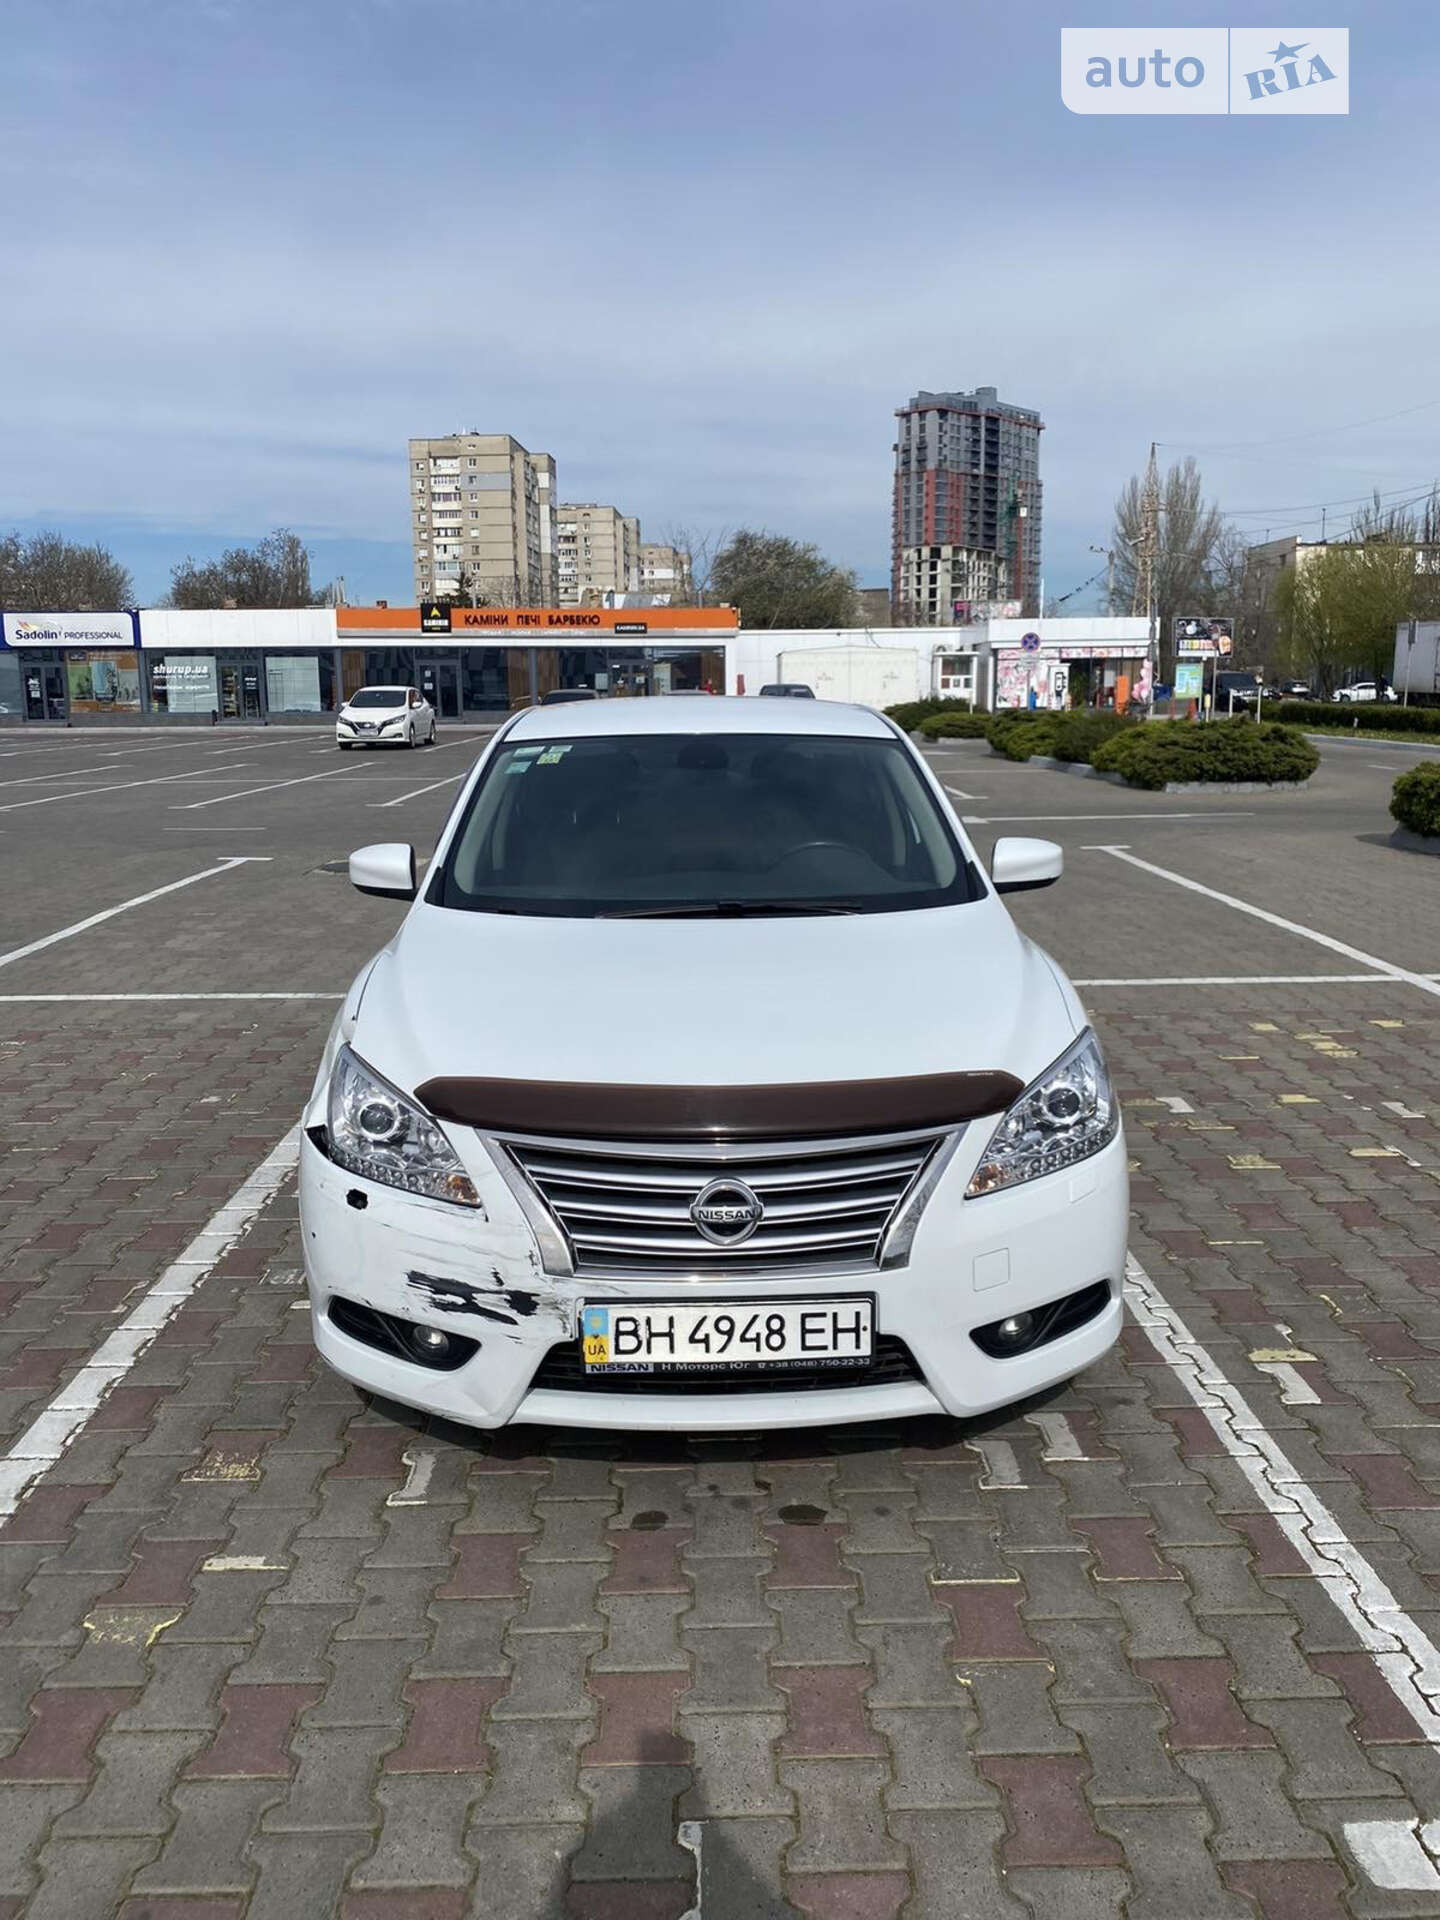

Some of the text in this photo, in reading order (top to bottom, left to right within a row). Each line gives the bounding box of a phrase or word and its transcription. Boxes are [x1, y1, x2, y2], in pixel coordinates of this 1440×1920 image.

[464, 614, 600, 626] КАМІНИ ПЕЧІ БАРБЕКЮ
[15, 629, 123, 640] Sadolin PROFESSIONAL
[153, 664, 208, 675] shurup.ua
[698, 1210, 756, 1220] NISSAN
[613, 1311, 862, 1356] BH 4948 EH
[588, 1344, 606, 1356] UA
[590, 1364, 650, 1372] NISSAN
[675, 1363, 727, 1371] Моторс
